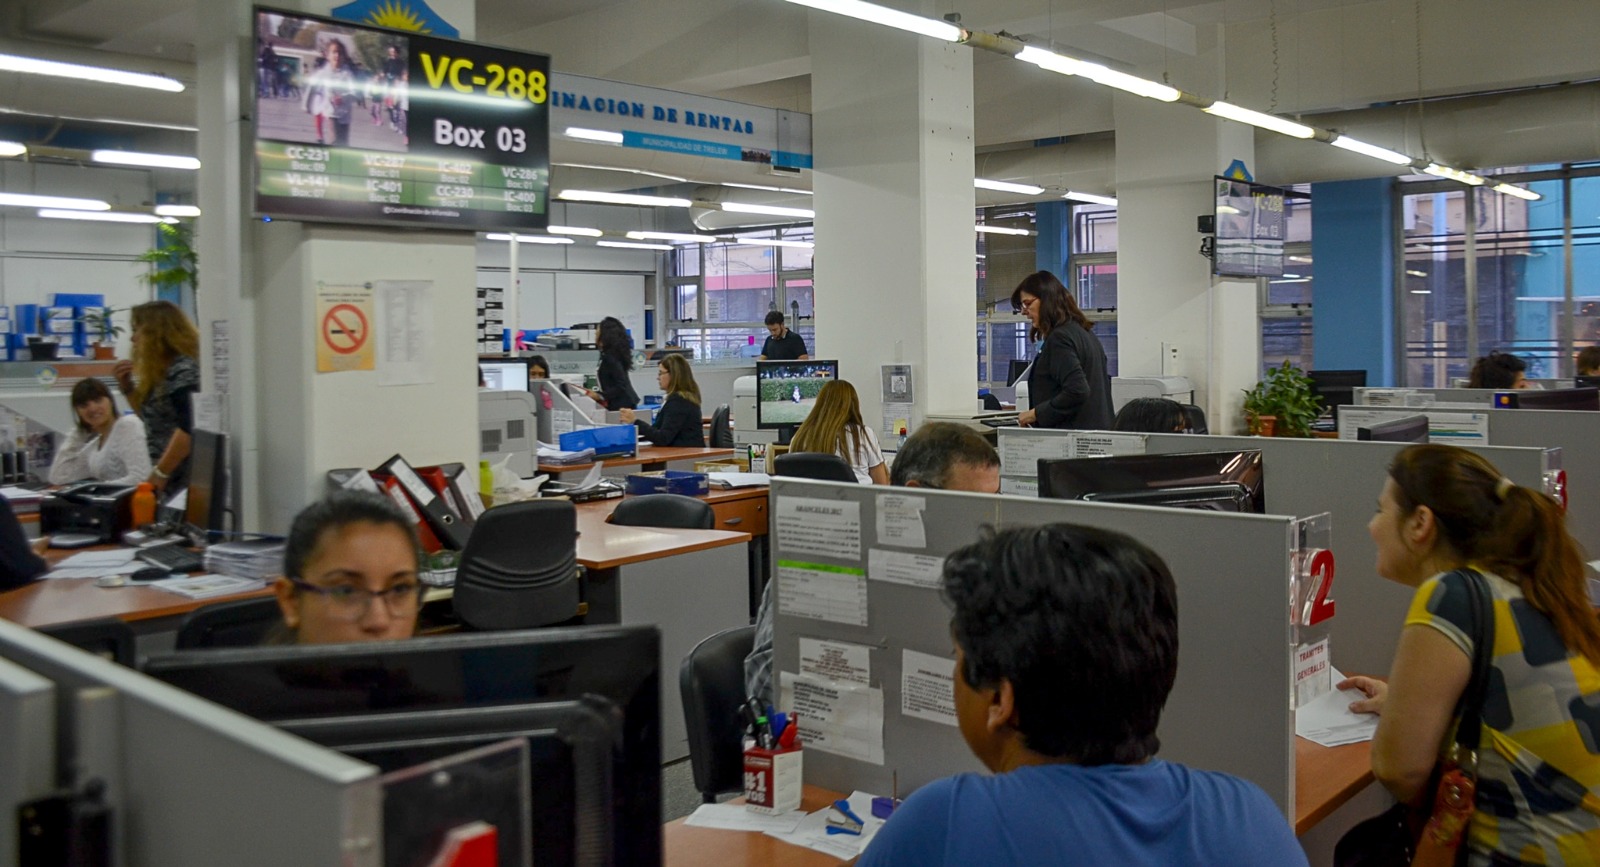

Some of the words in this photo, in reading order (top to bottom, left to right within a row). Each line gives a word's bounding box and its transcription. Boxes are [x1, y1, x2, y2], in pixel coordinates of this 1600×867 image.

[420, 53, 546, 104] VC-288
[653, 106, 678, 123] DE
[685, 111, 754, 134] RENTAS
[435, 119, 485, 149] Box
[497, 127, 526, 153] 03
[502, 167, 537, 180] VC-286
[1307, 549, 1335, 626] 2
[1297, 660, 1326, 681] GENERALES
